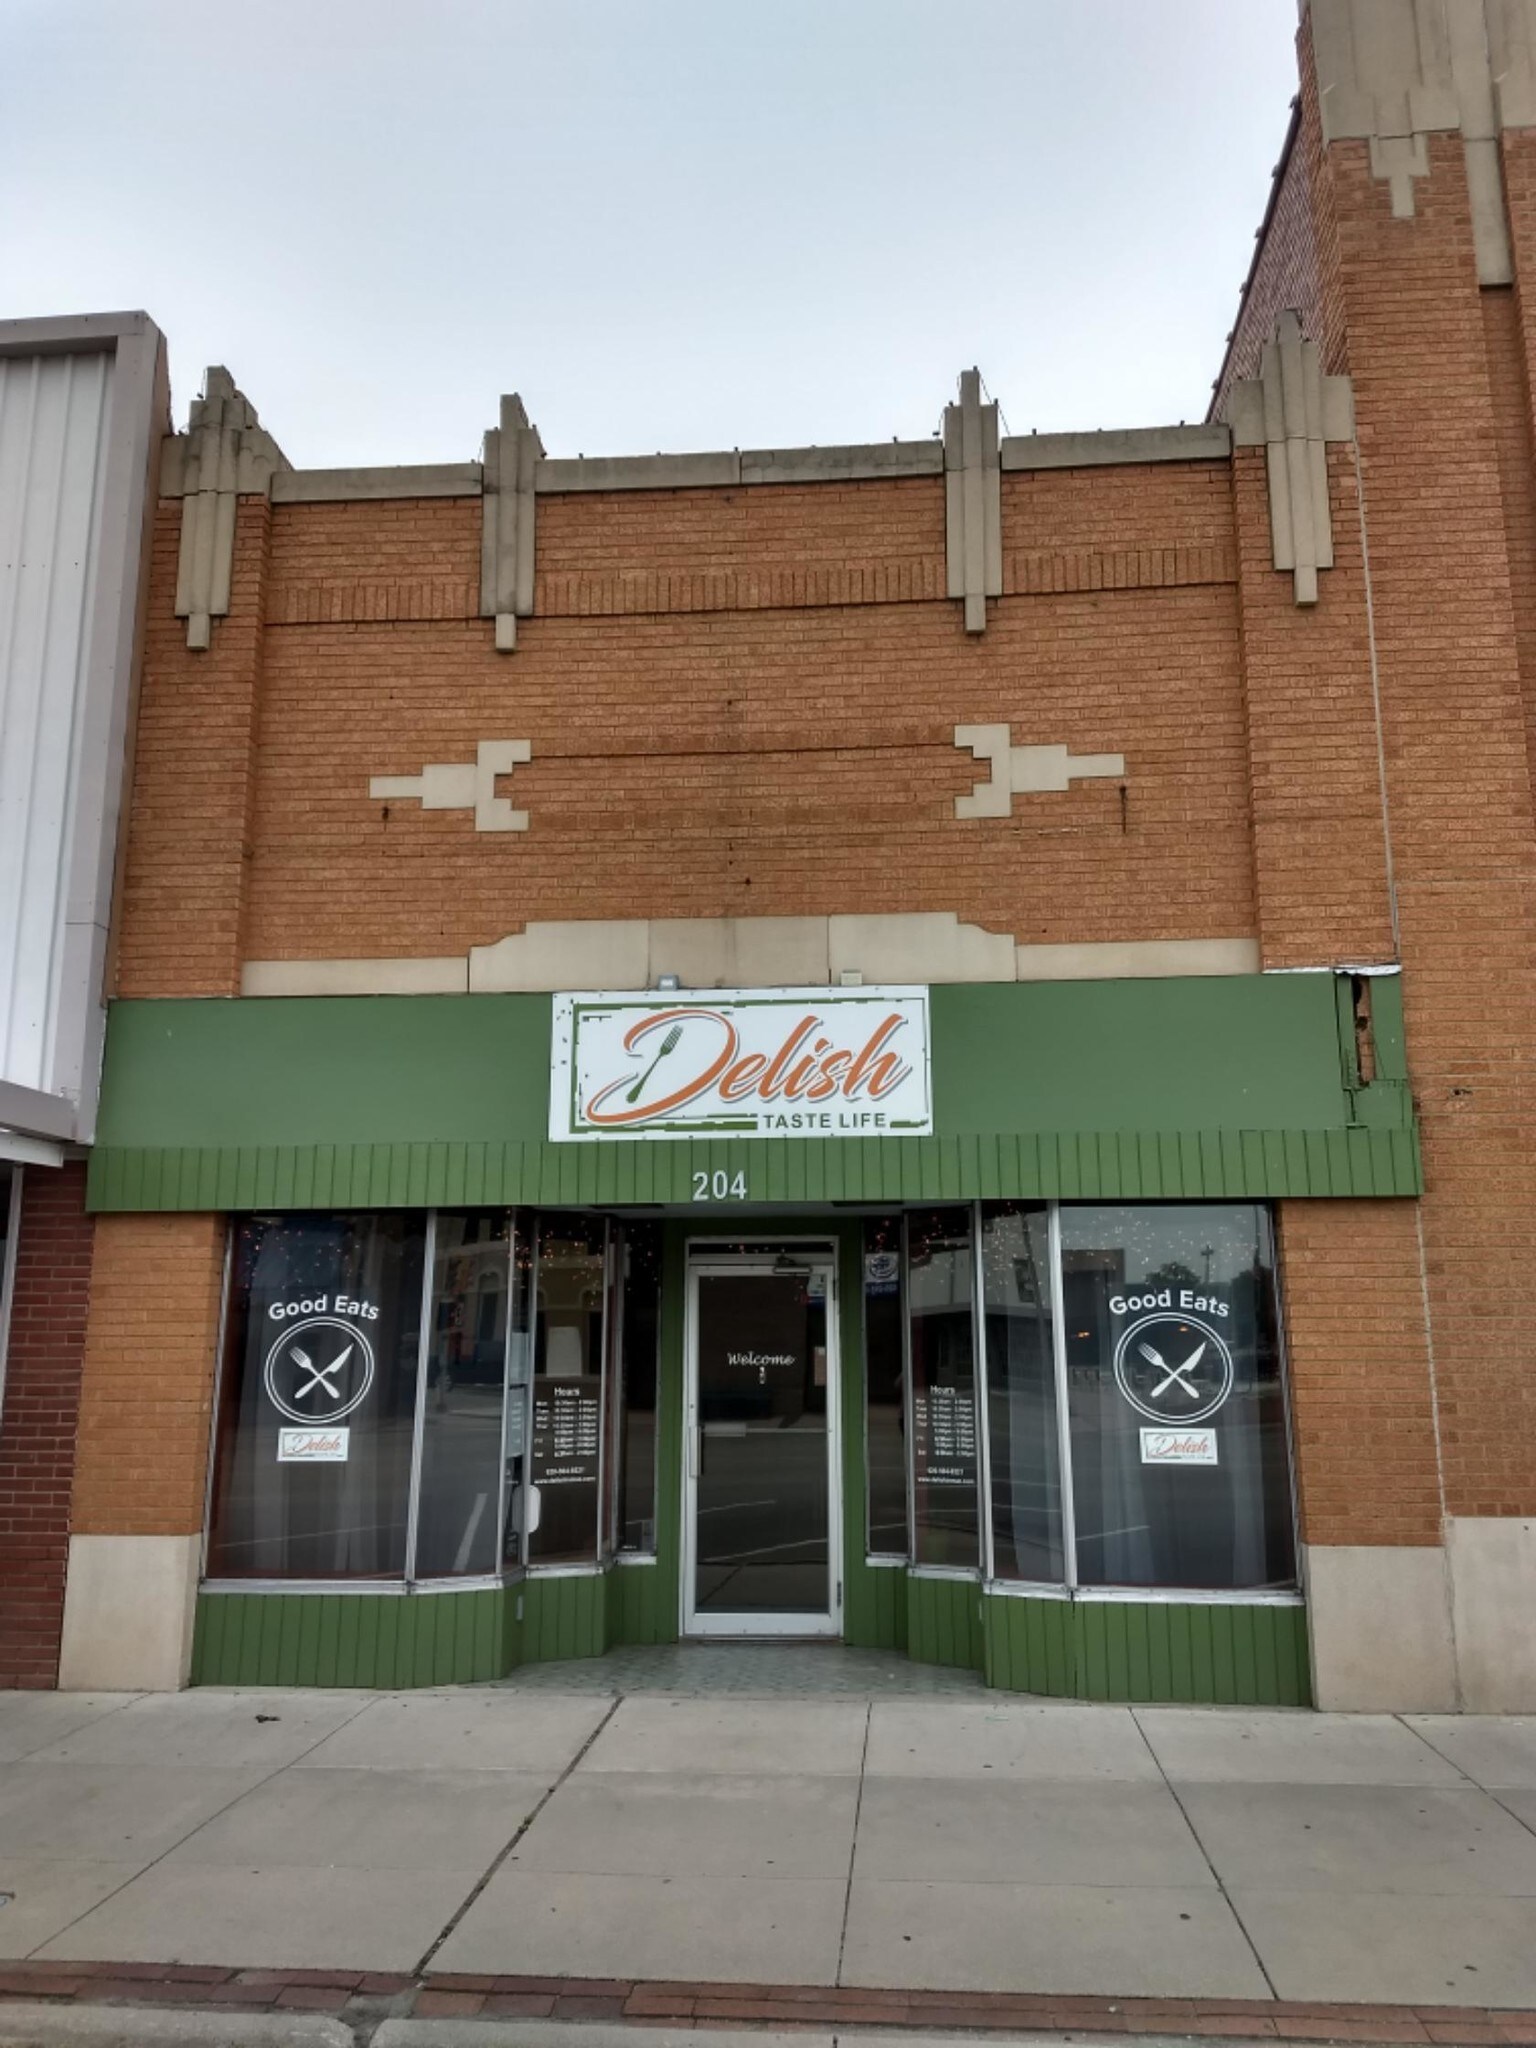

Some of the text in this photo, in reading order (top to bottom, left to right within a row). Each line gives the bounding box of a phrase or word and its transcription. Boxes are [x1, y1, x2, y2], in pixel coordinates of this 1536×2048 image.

[586, 1009, 912, 1125] Delish
[763, 1112, 886, 1129] TASTE LIFE
[692, 1170, 747, 1201] 204
[268, 1294, 379, 1321] Good Eats
[1108, 1289, 1230, 1317] Good Eats
[727, 1350, 796, 1366] Welcome
